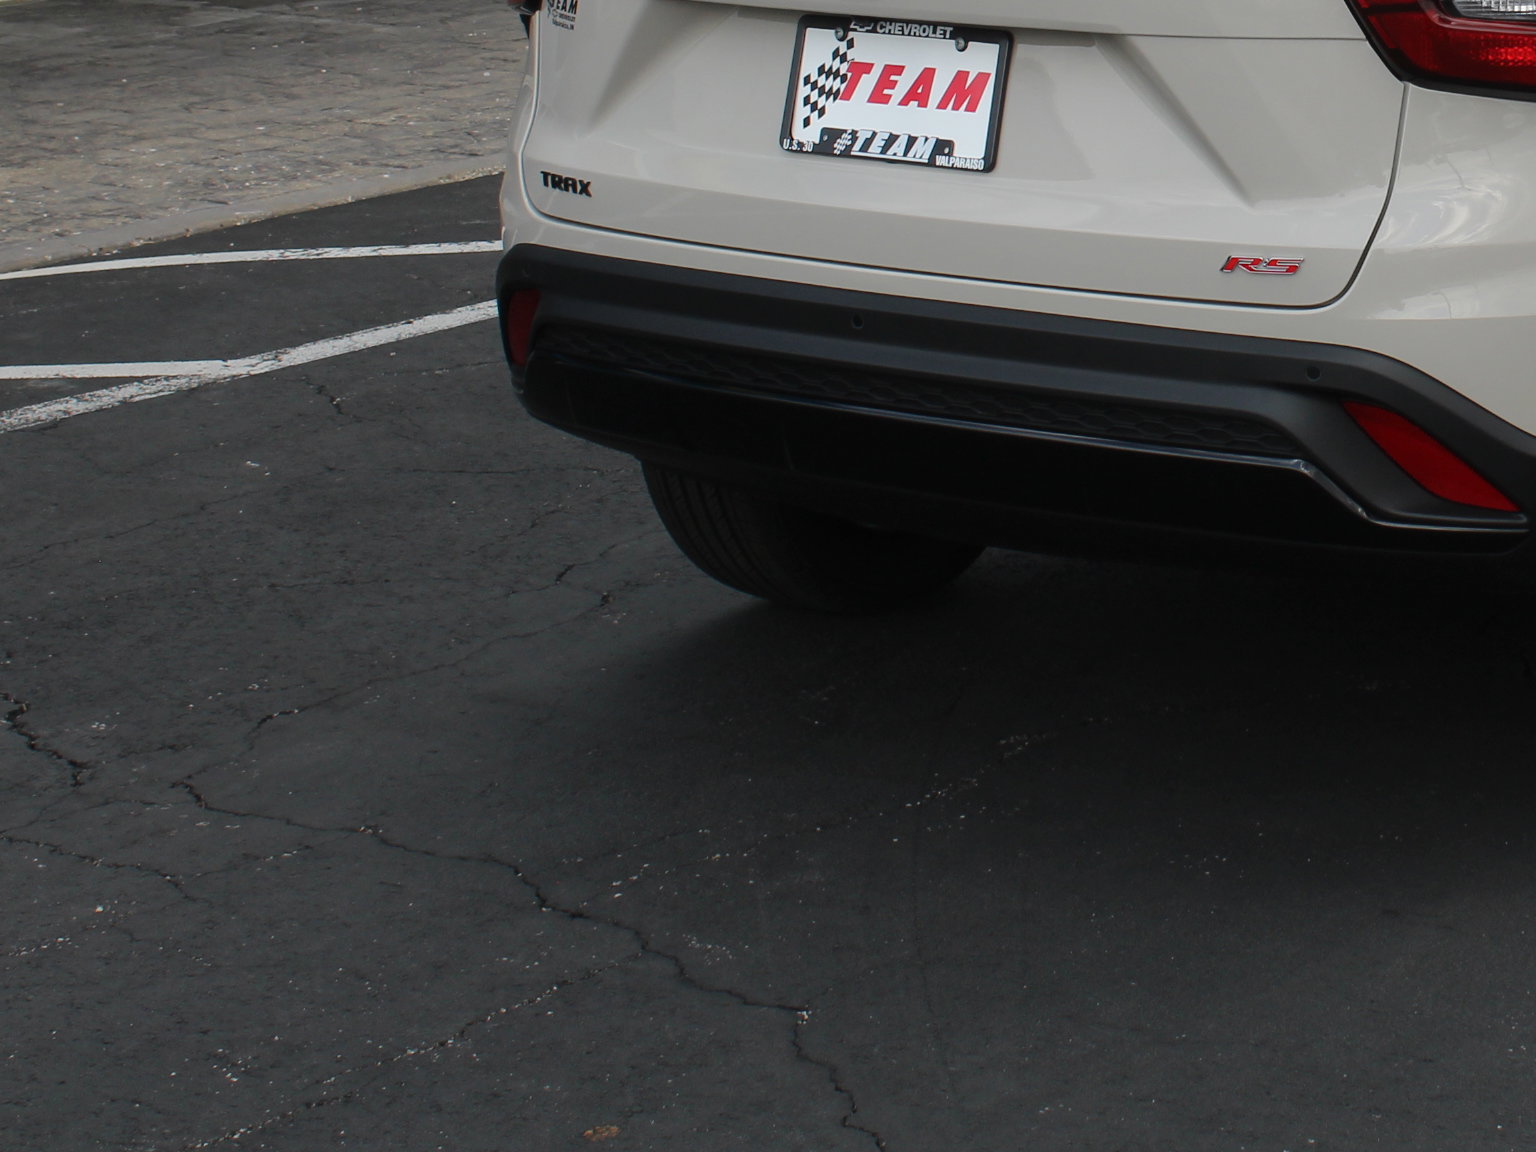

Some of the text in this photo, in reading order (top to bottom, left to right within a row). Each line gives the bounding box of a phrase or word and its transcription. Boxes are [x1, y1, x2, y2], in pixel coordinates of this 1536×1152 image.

[876, 21, 954, 39] CHEVROLET
[838, 61, 992, 113] TEAM
[783, 138, 814, 152] U.S. 30
[851, 129, 937, 160] TEAM
[935, 155, 985, 171] VALPARAISO
[540, 170, 592, 198] TRAX
[1220, 255, 1304, 275] RS
